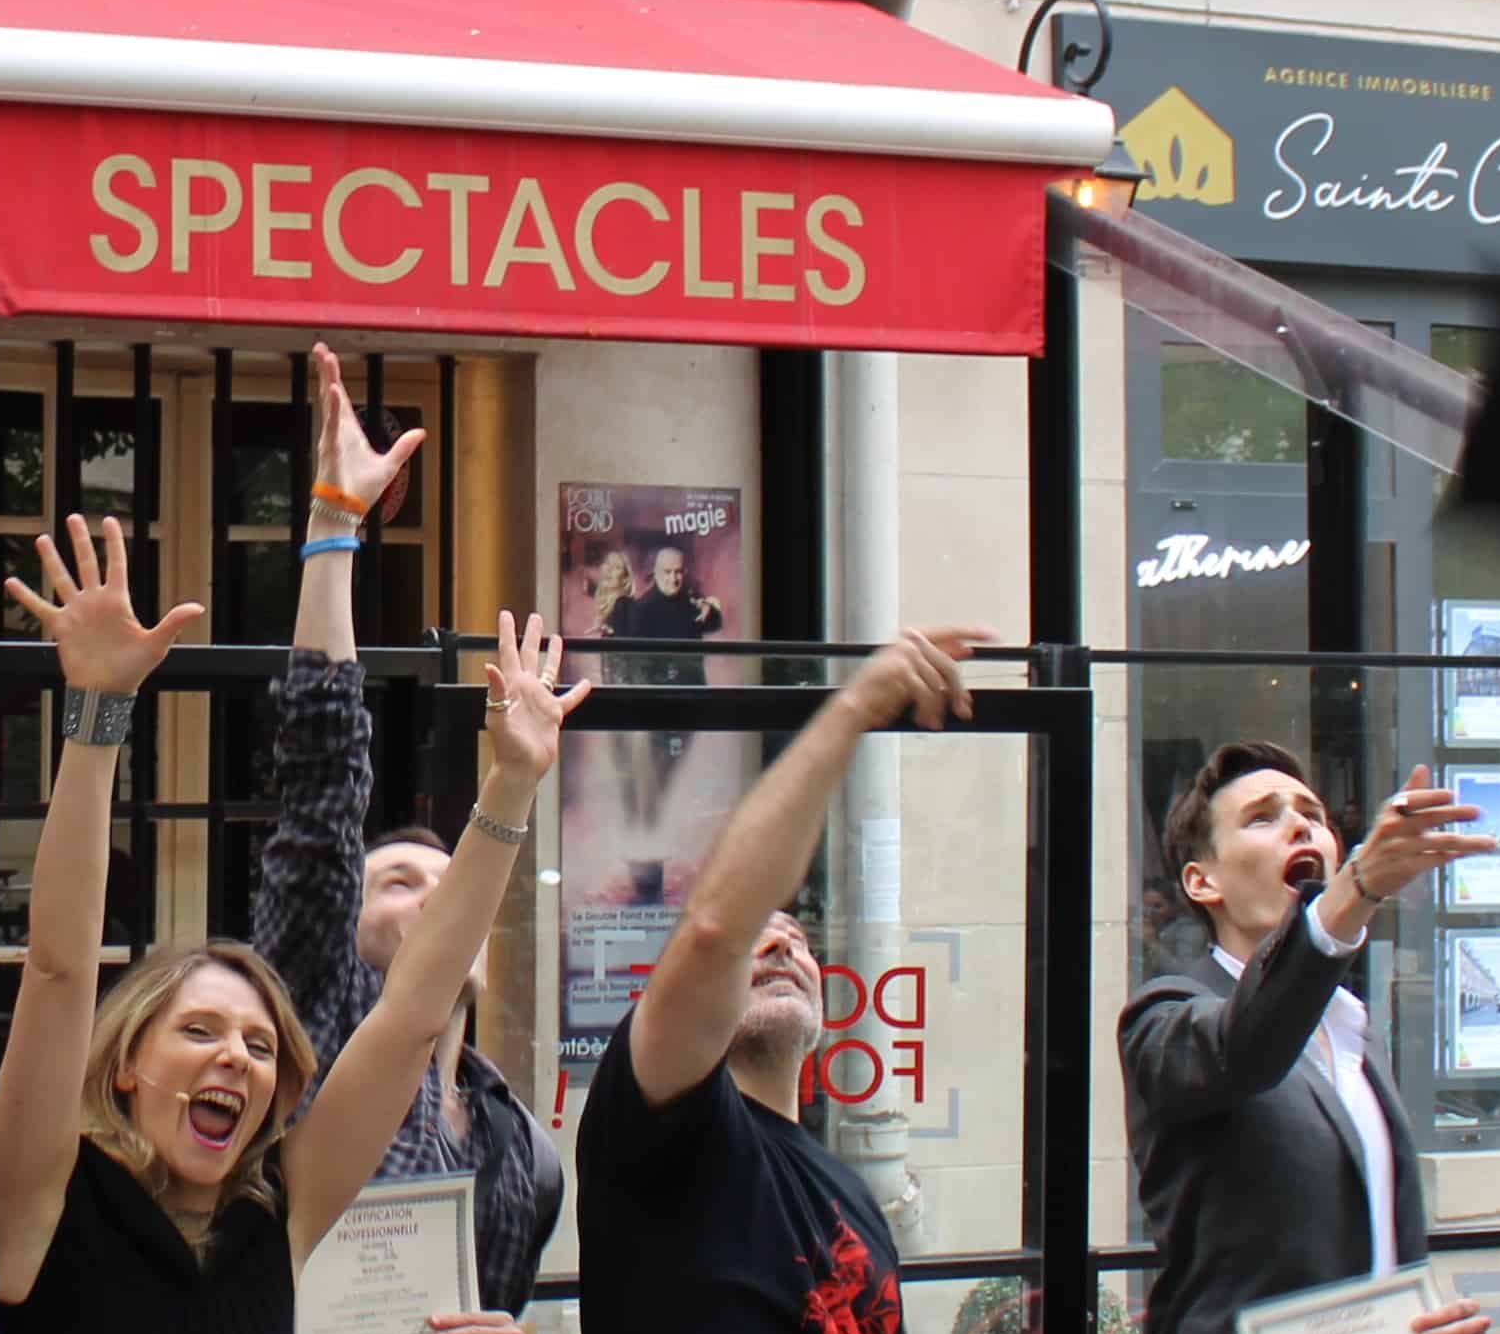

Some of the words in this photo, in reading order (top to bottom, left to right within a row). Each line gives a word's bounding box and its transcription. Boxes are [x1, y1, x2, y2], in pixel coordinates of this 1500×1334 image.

[1264, 66, 1350, 90] AGENCE
[1264, 112, 1459, 220] Sainte
[88, 152, 868, 307] SPECTACLES
